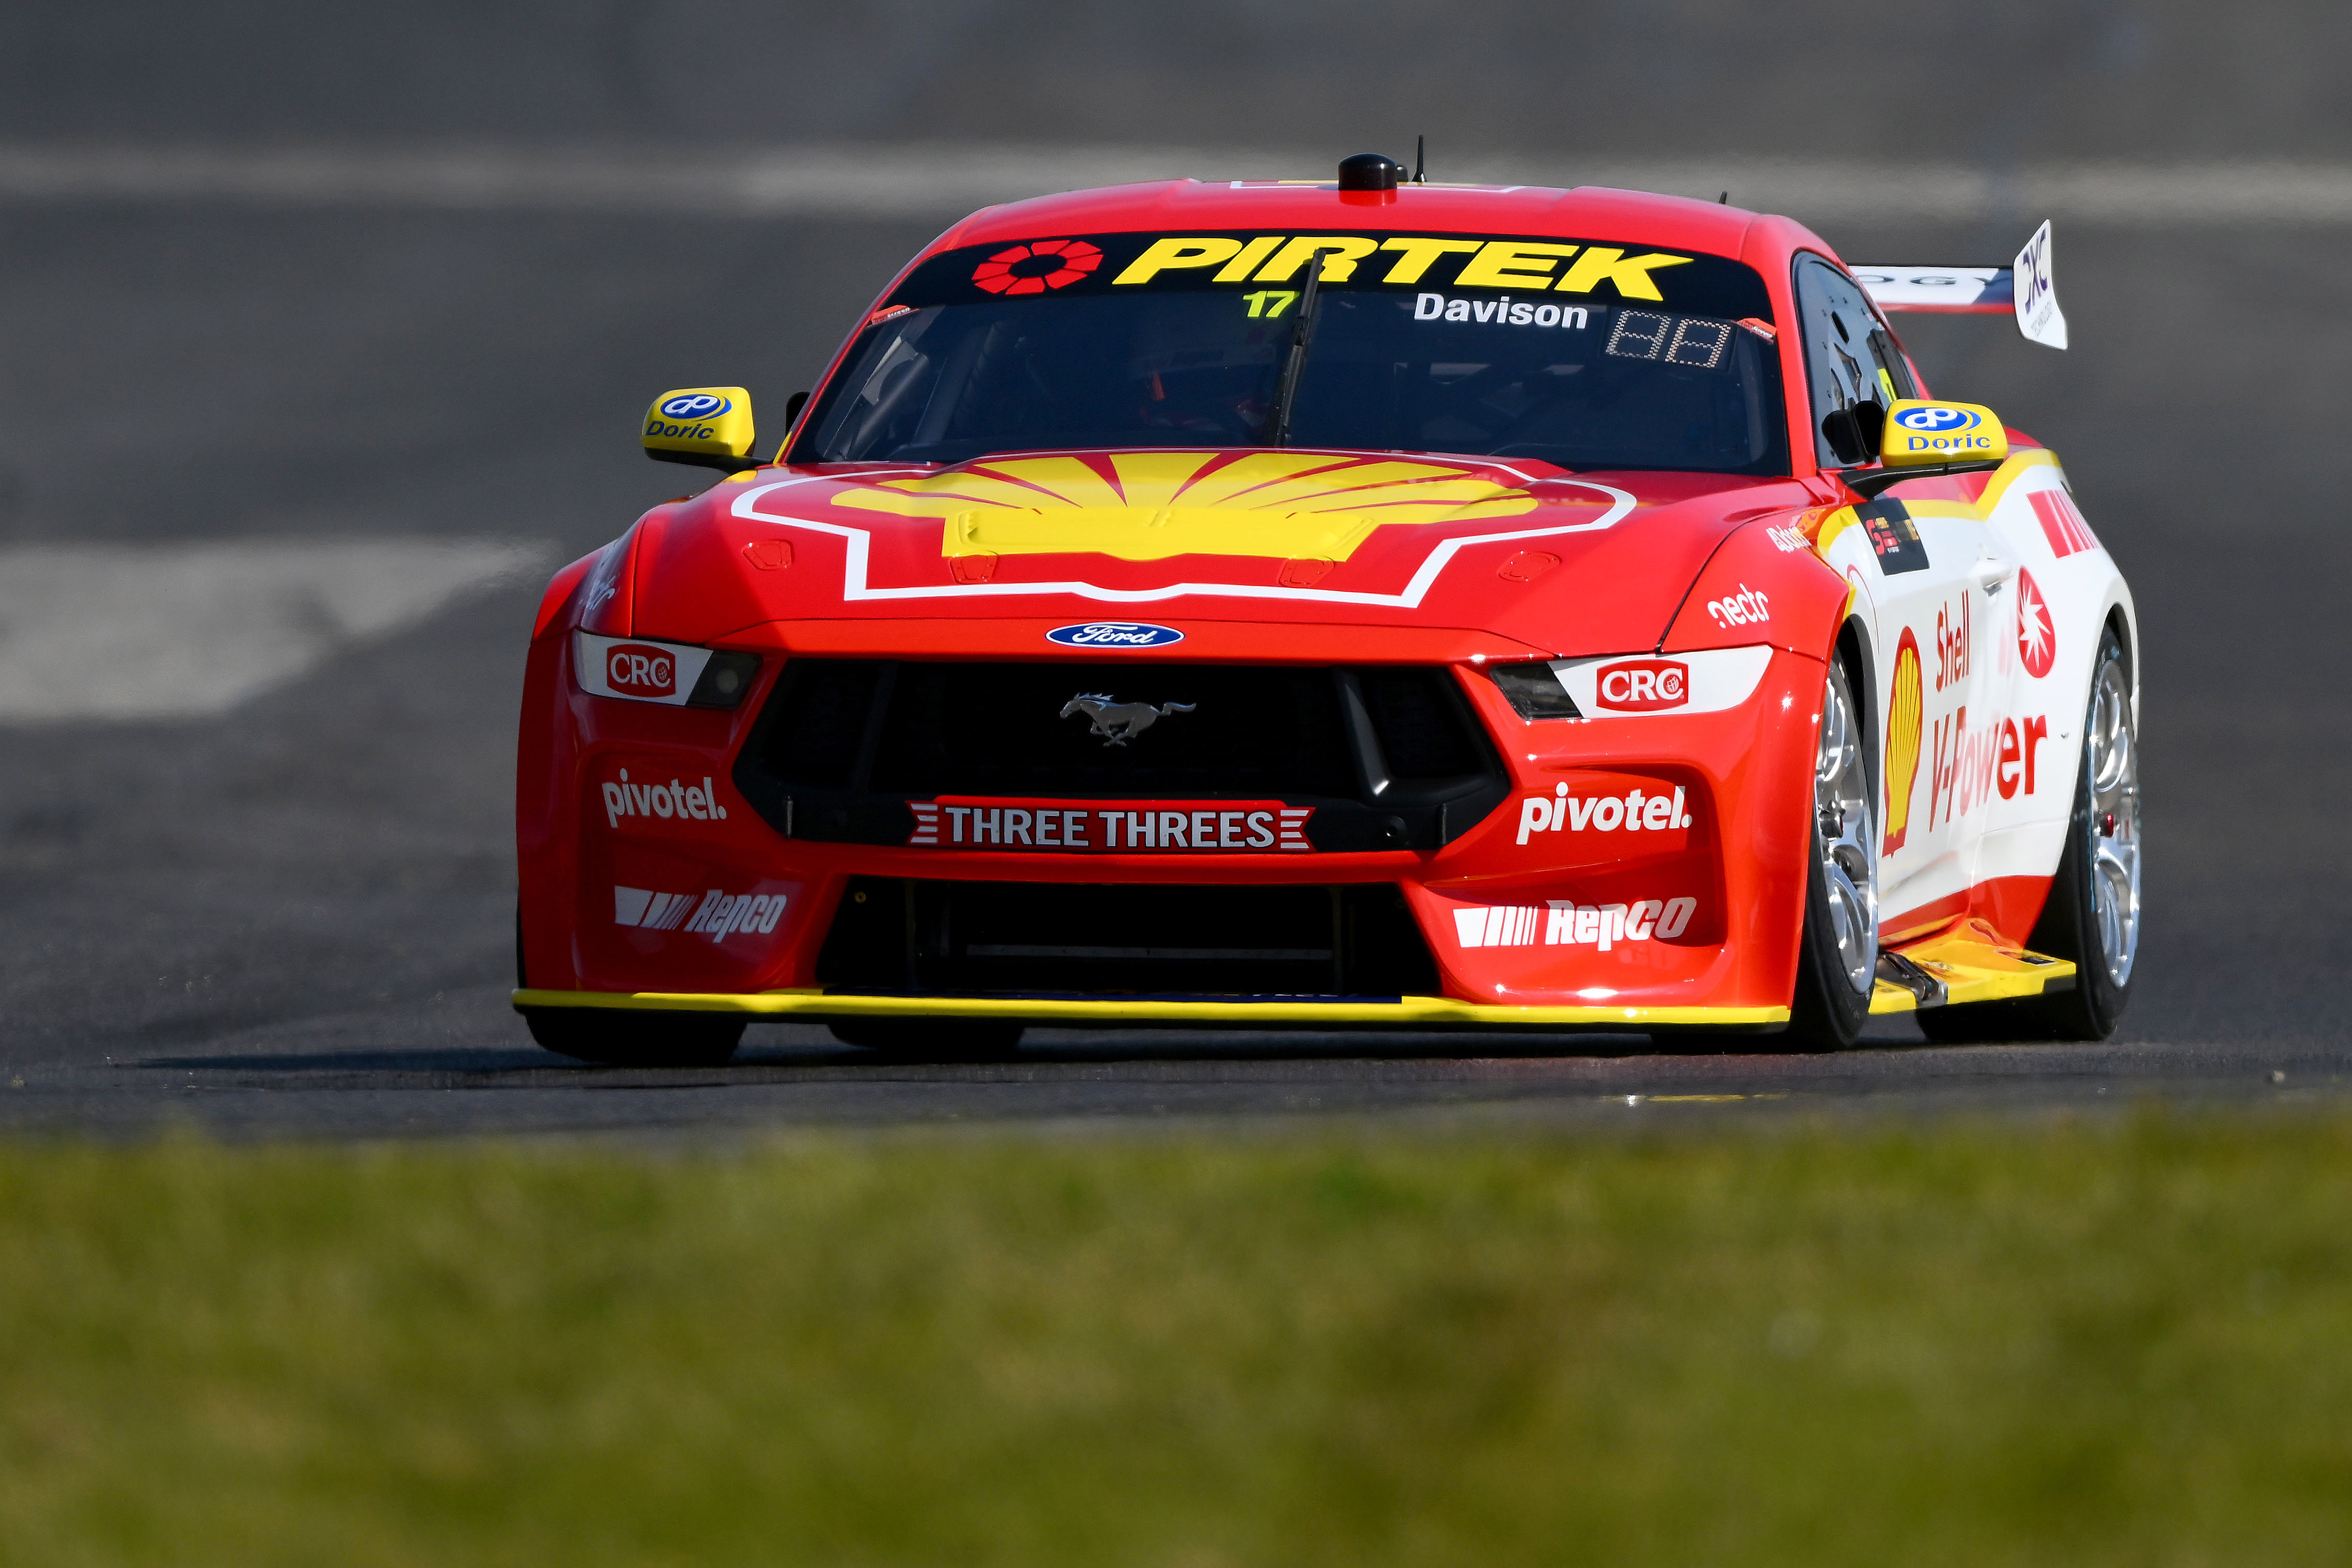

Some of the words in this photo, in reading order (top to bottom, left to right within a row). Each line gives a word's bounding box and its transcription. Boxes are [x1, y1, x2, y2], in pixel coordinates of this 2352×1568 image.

[1112, 237, 1695, 301] PIRTEK
[1242, 290, 1300, 318] 17
[1414, 293, 1588, 329] Davison
[646, 421, 714, 439] Doric
[1908, 434, 1991, 451] Doric
[1072, 624, 1158, 645] Ford
[1935, 589, 1971, 692] Shell
[610, 653, 671, 688] CRC
[1602, 668, 1683, 701] CRC
[1929, 705, 2048, 833] V-Power
[945, 807, 1089, 847] THREE
[1099, 811, 1274, 848] THREES
